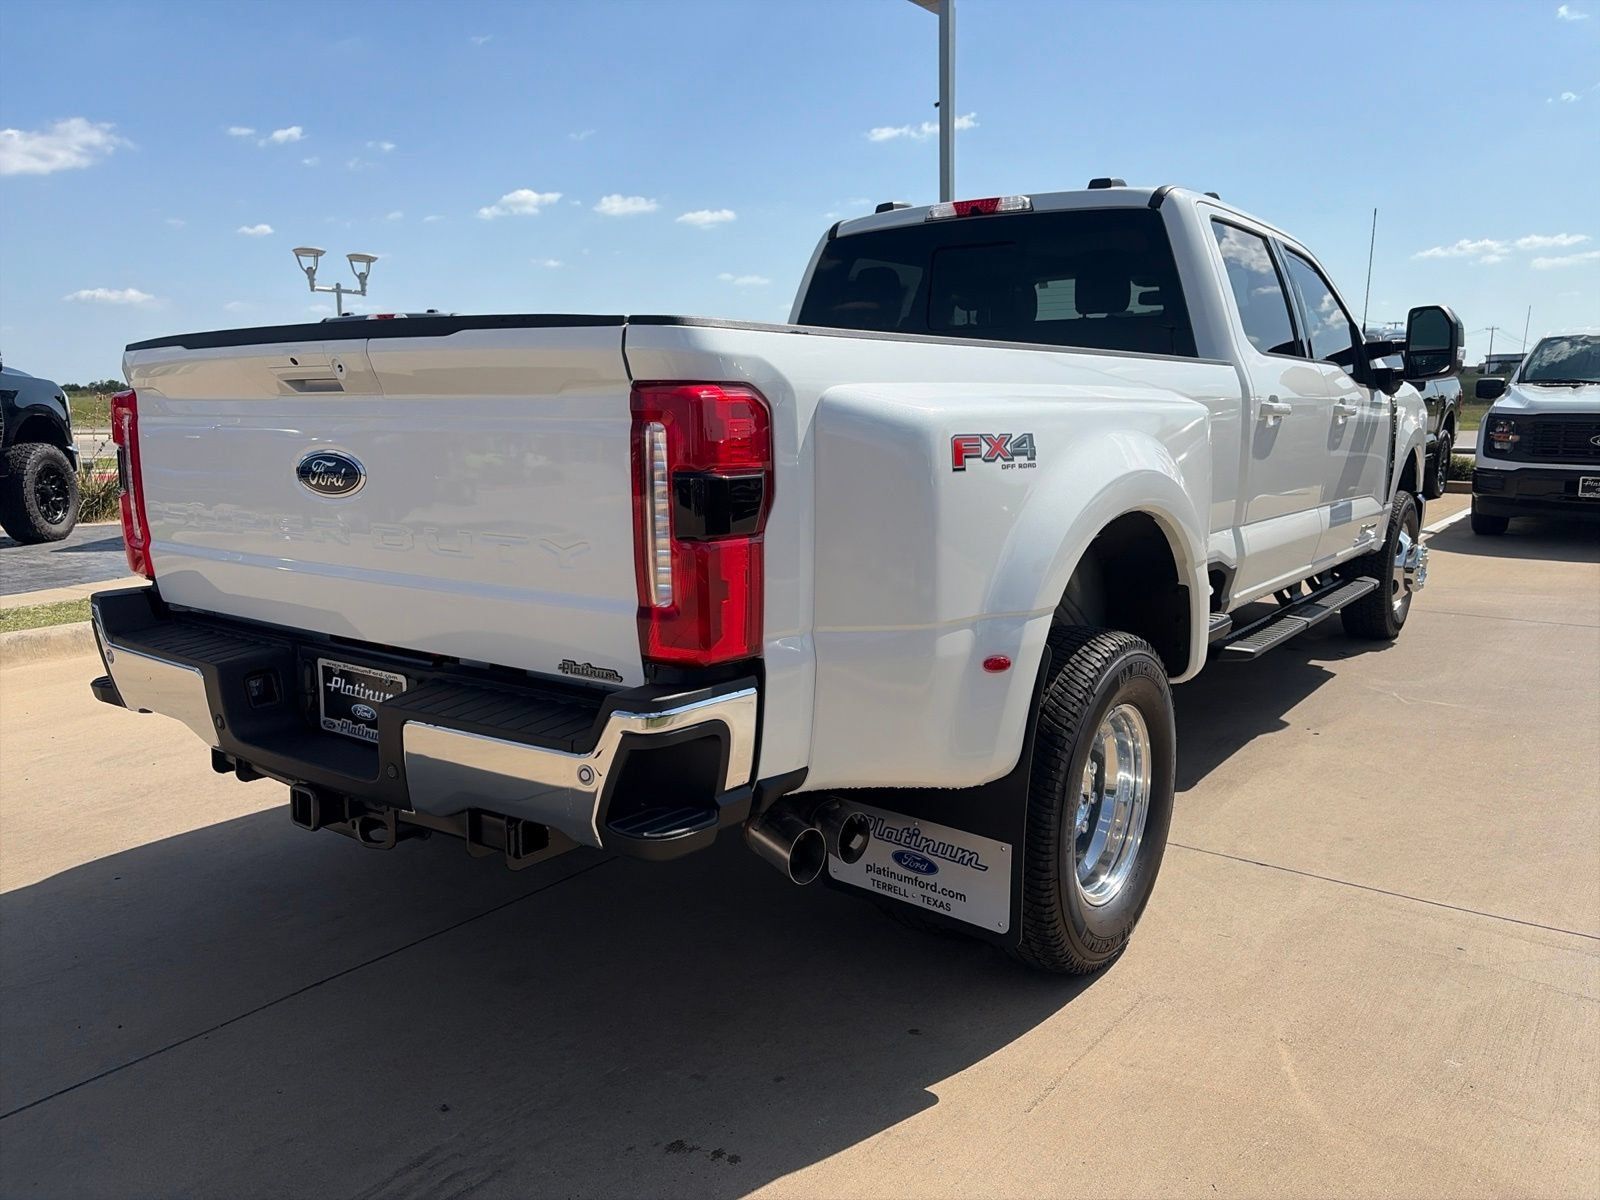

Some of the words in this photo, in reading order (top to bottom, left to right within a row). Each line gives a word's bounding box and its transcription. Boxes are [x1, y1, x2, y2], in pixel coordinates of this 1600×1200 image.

[951, 433, 1036, 472] FX4
[309, 459, 346, 487] Ford
[369, 521, 593, 570] DUTY
[558, 659, 623, 683] Platinum
[338, 719, 379, 740] Platinu
[865, 814, 988, 872] Platinum
[900, 852, 929, 872] Ford
[865, 863, 967, 903] platinumford.com
[870, 878, 909, 899] TERRELL
[920, 894, 952, 912] TEXAS
